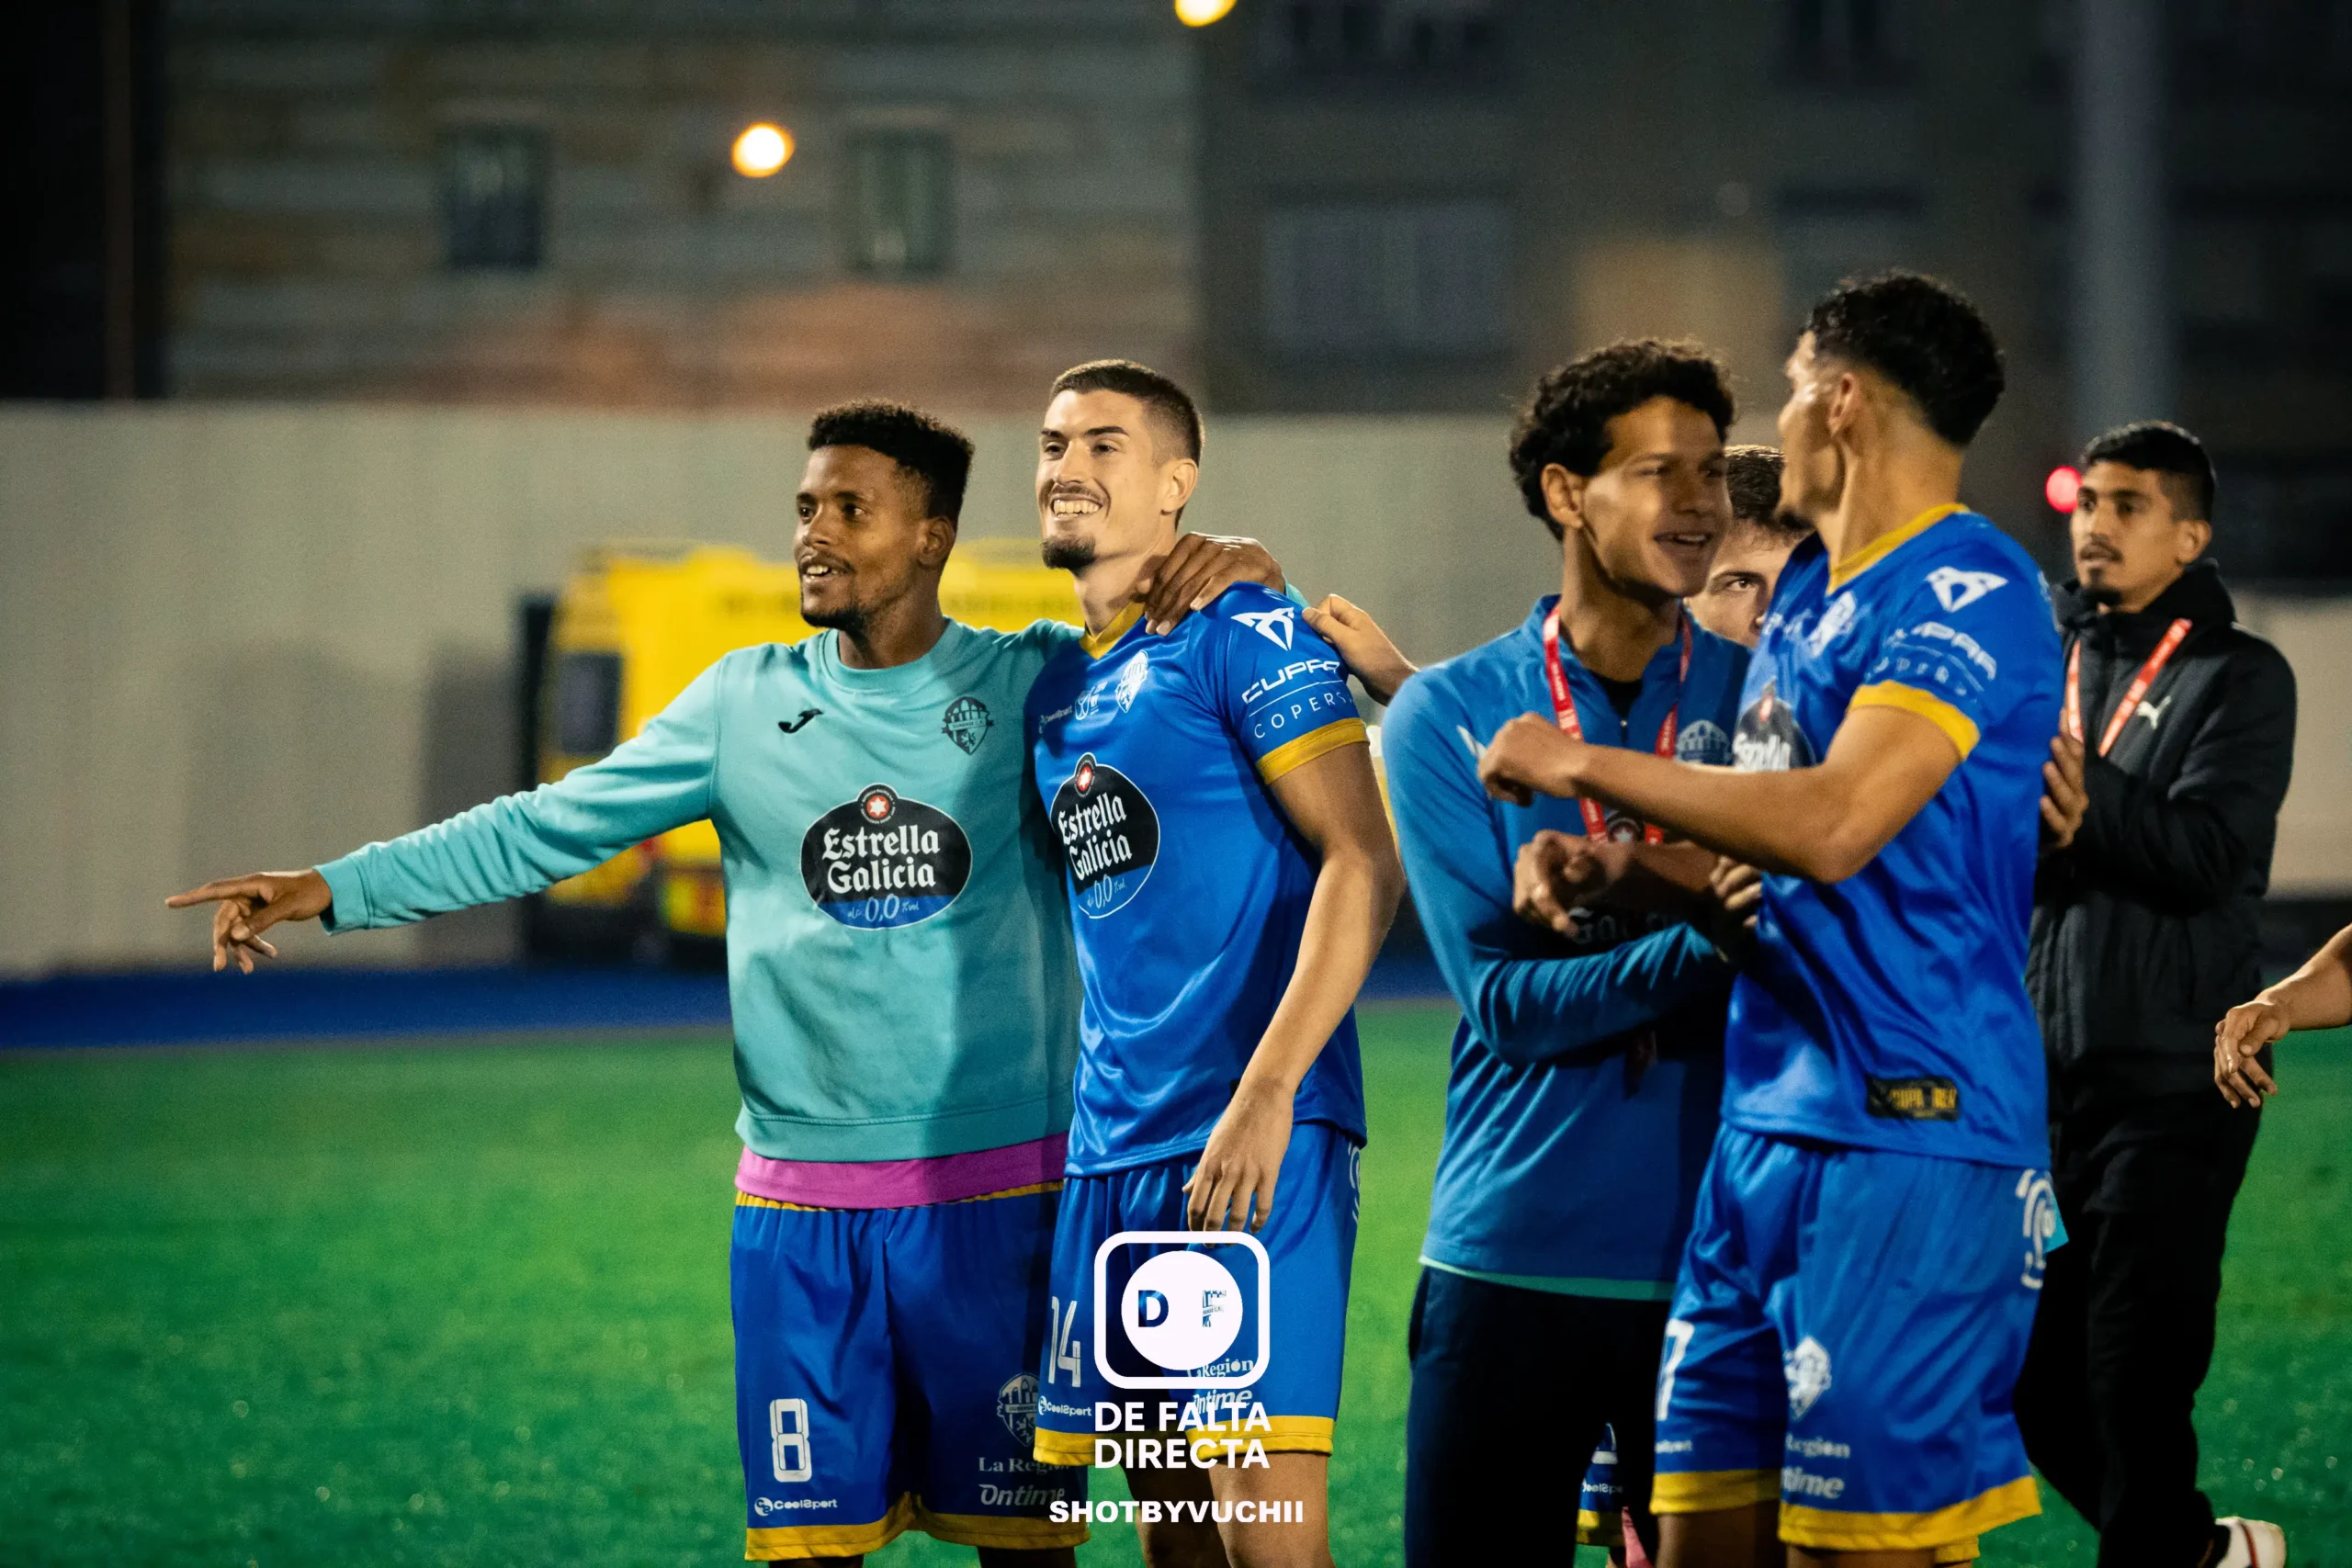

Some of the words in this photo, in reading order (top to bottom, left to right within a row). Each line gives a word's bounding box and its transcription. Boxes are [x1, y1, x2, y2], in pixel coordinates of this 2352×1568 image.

[1254, 692, 1352, 739] COPERS
[1058, 792, 1127, 845] Estrella
[821, 824, 941, 861] Estrella
[1069, 829, 1133, 881] Galicia
[828, 856, 936, 894] Galicia
[865, 893, 900, 922] 0,0
[1048, 1295, 1081, 1388] 14
[769, 1398, 812, 1483] 8
[978, 1457, 1003, 1472] La
[1781, 1467, 1845, 1499] time
